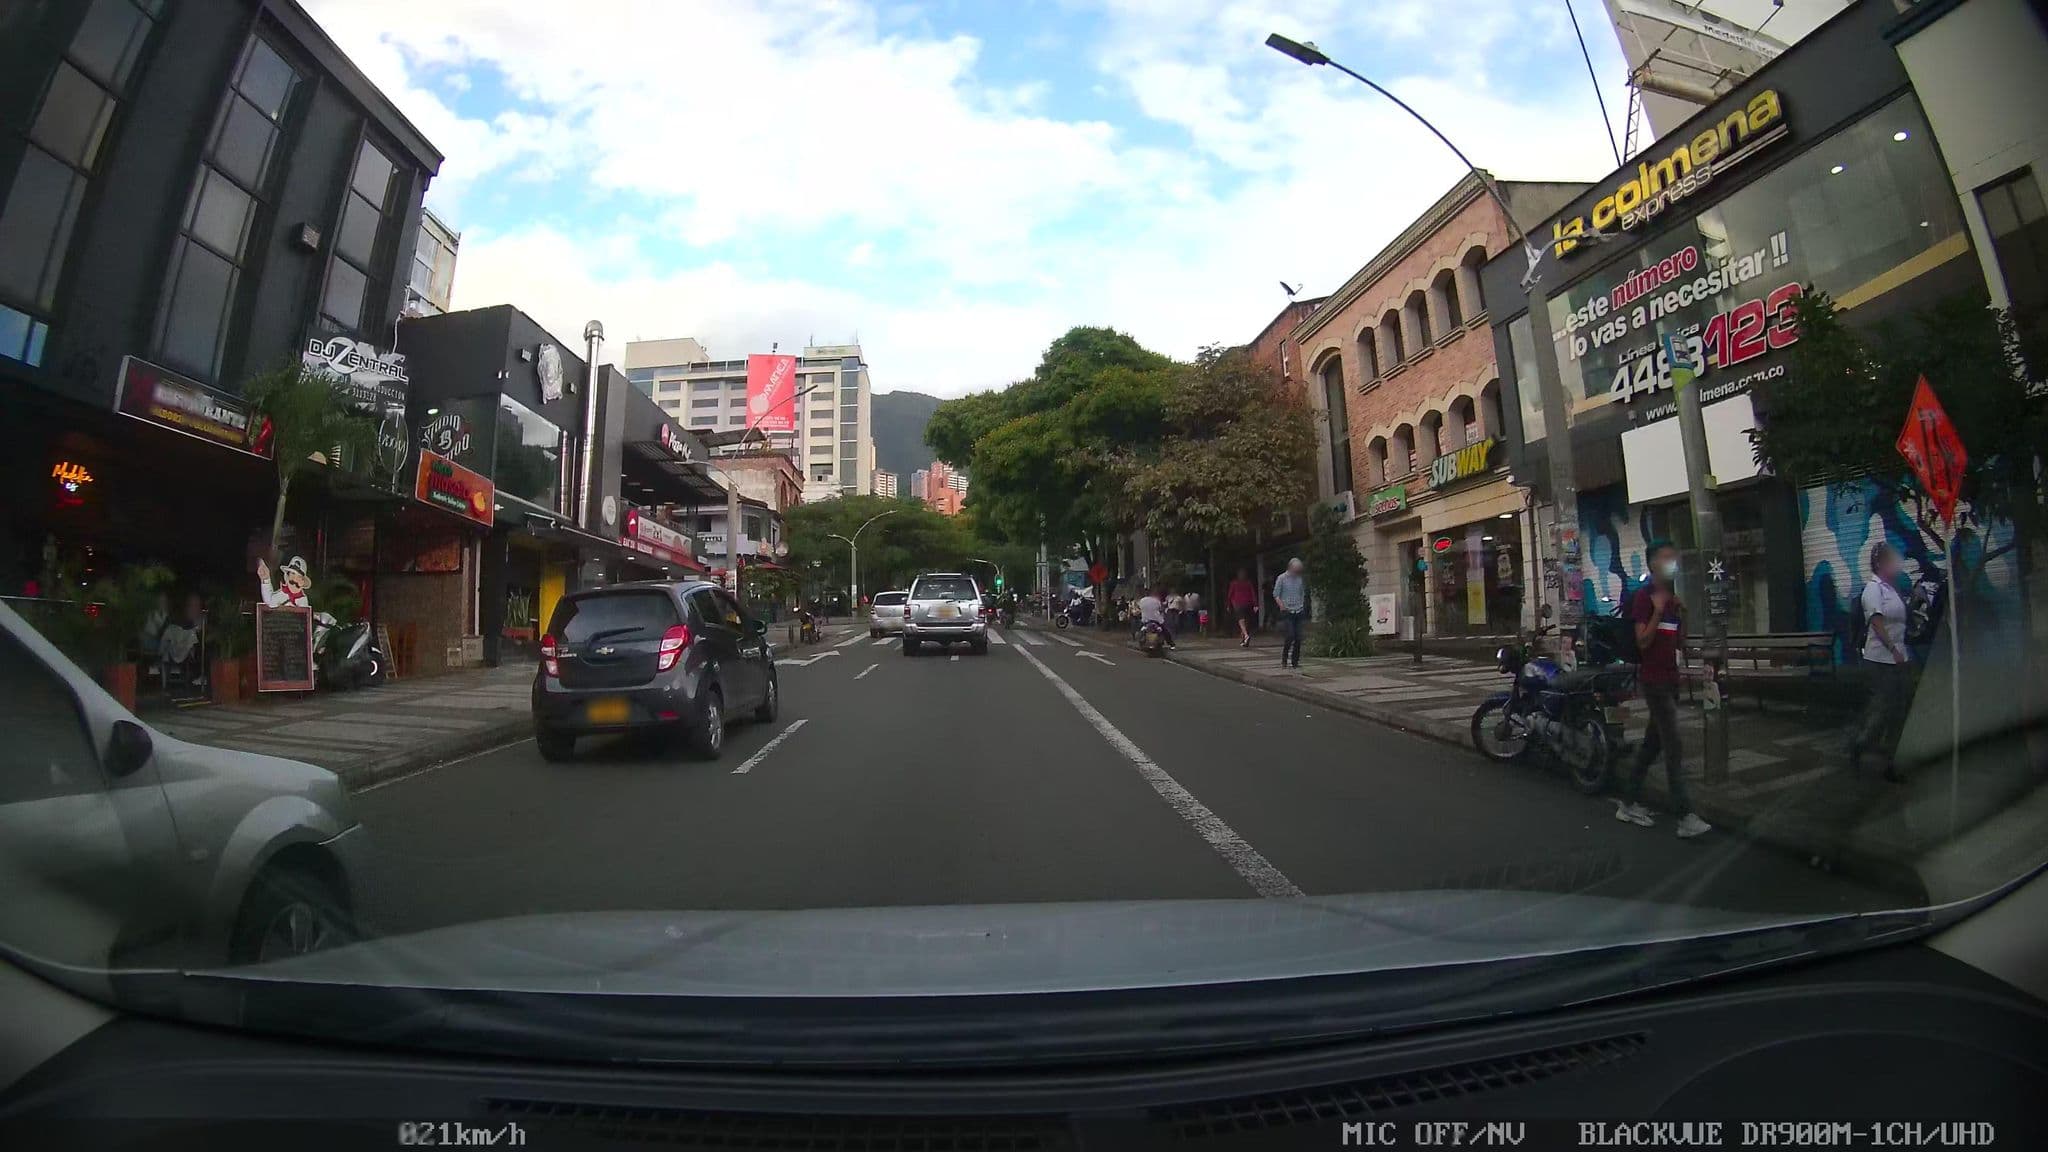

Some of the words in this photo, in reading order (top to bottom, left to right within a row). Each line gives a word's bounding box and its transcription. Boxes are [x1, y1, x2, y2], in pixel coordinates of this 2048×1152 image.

[1552, 215, 1585, 261] la
[1591, 88, 1783, 230] colmena
[1621, 164, 1714, 232] express
[1569, 332, 1588, 361] lo
[1590, 315, 1628, 349] vas
[1631, 305, 1647, 329] a
[1649, 247, 1766, 321] necesitar
[1611, 246, 1698, 311] número
[1618, 341, 1657, 365] Línea
[1428, 438, 1494, 489] SUBWAY
